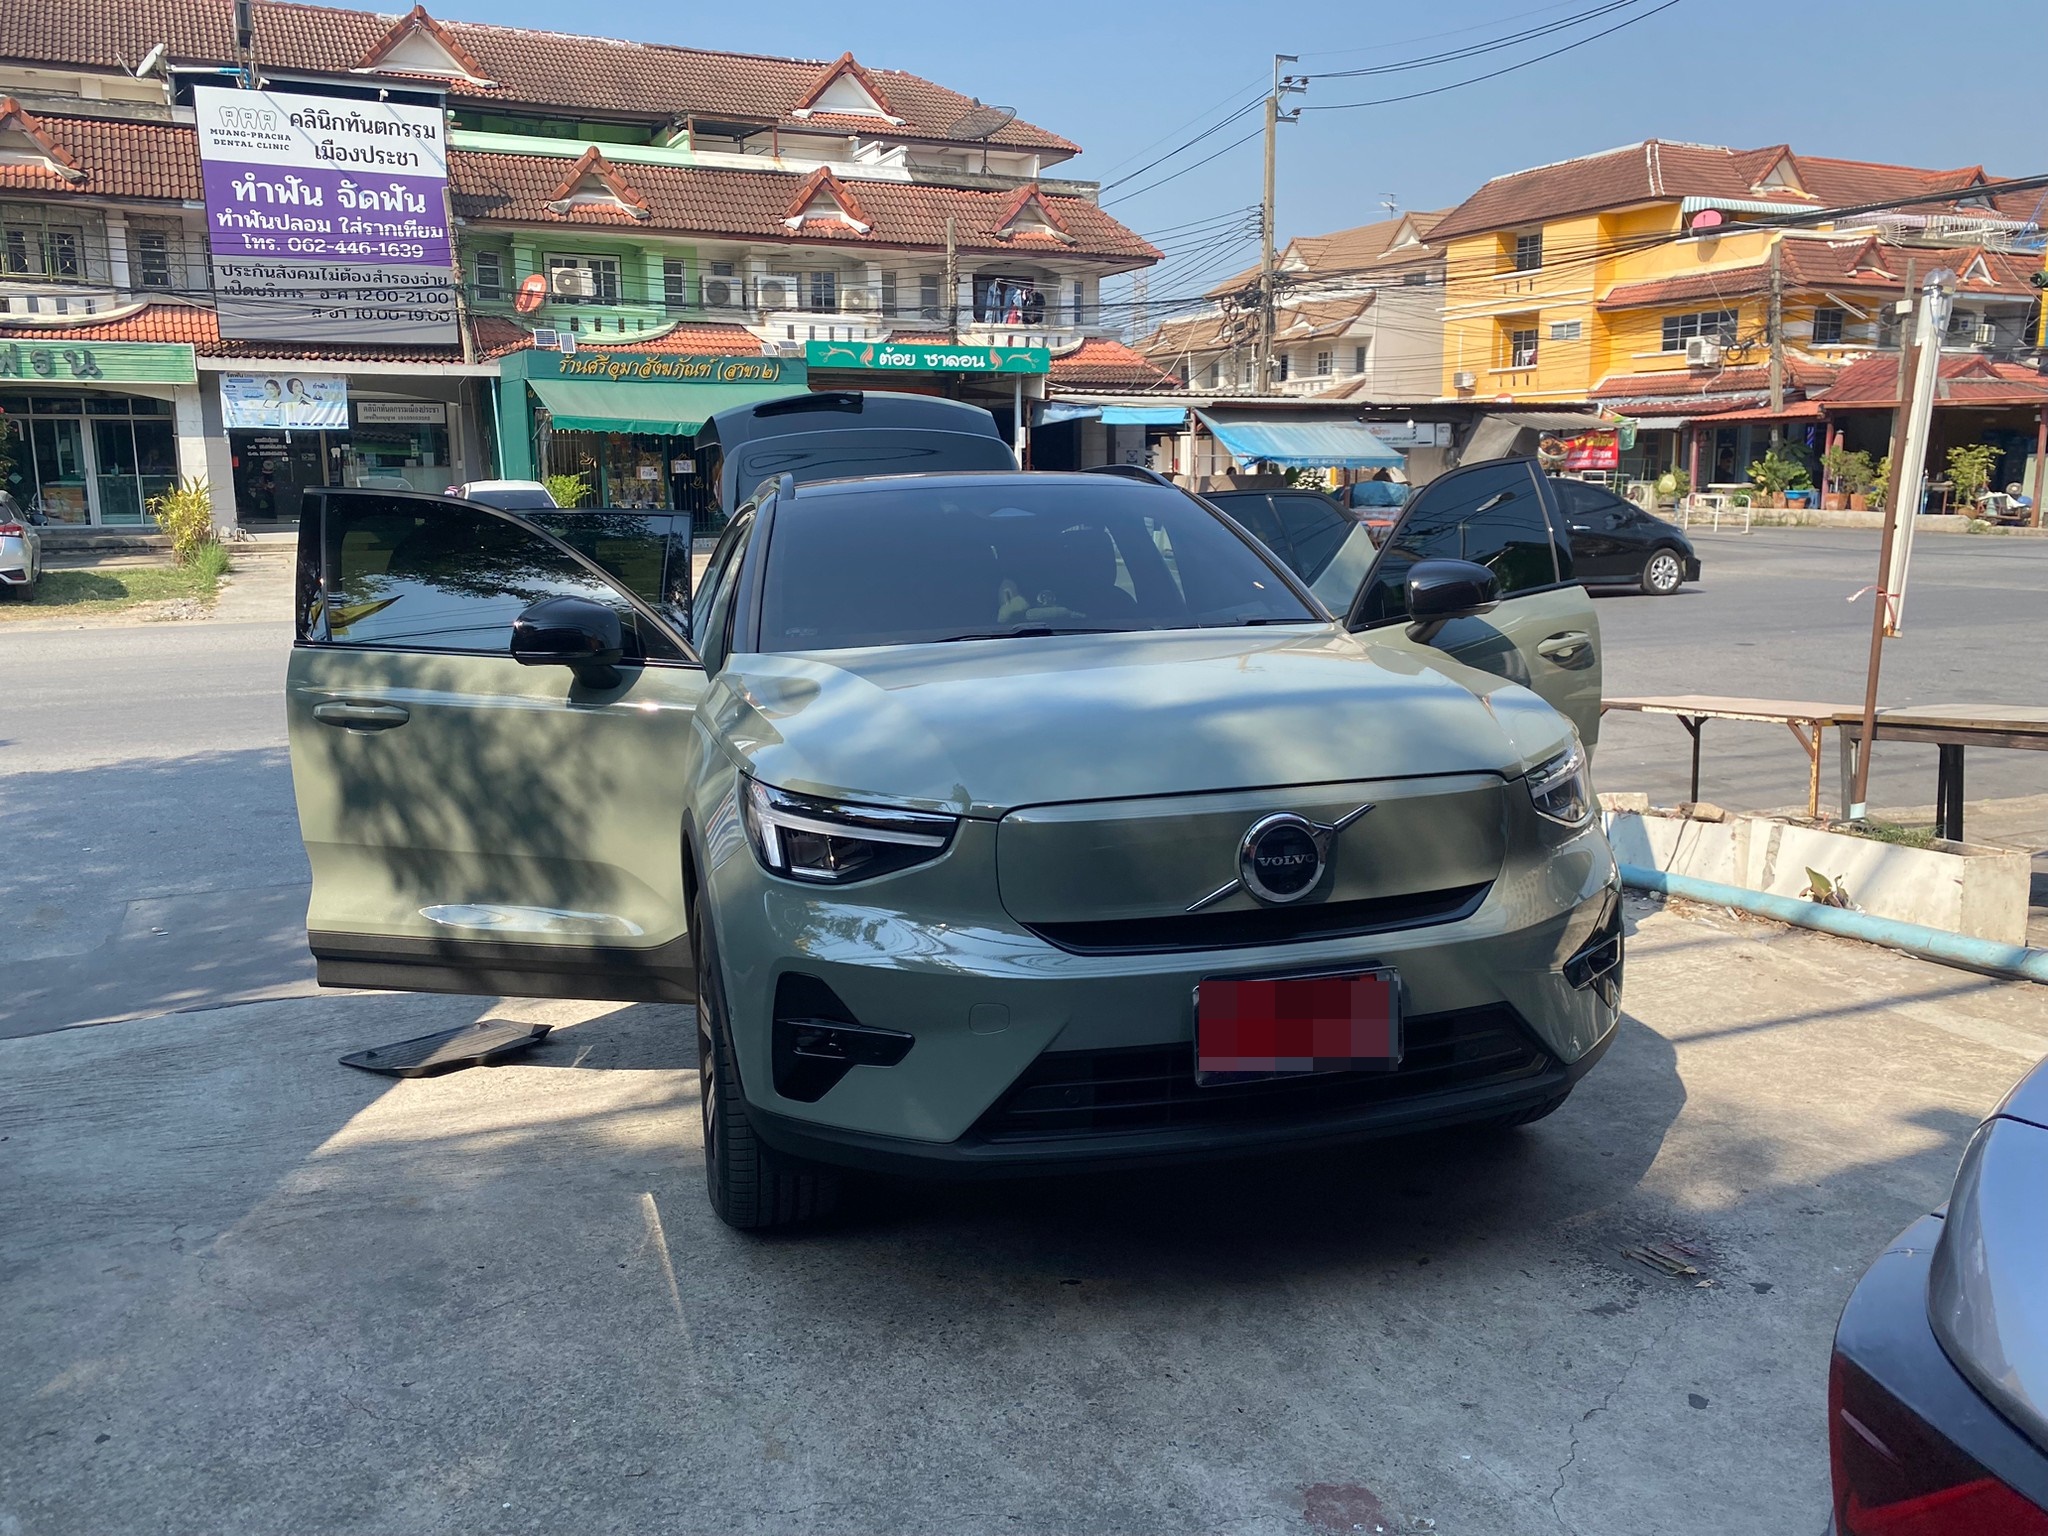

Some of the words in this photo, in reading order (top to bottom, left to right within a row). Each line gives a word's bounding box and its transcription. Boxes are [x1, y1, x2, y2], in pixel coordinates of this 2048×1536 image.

[210, 128, 292, 141] MUANG-PRACHA
[290, 107, 436, 140] คลินิกทันตกรรม
[213, 138, 254, 148] DENTAL
[256, 142, 290, 151] CLINIC
[315, 139, 419, 167] เมืองประชา
[231, 172, 324, 207] ทำฟัน
[337, 179, 426, 214] จัดฟัน
[216, 207, 331, 233] ทำฟันปลอม
[338, 216, 444, 239] ใส่รากเทียม
[241, 233, 281, 251] โทร.
[287, 237, 424, 258] 062-446-1639
[355, 290, 449, 304] 12.00-21.00
[879, 346, 916, 366] ต้อย
[924, 354, 985, 368] ซาลอน
[1257, 853, 1315, 866] VOLVO
